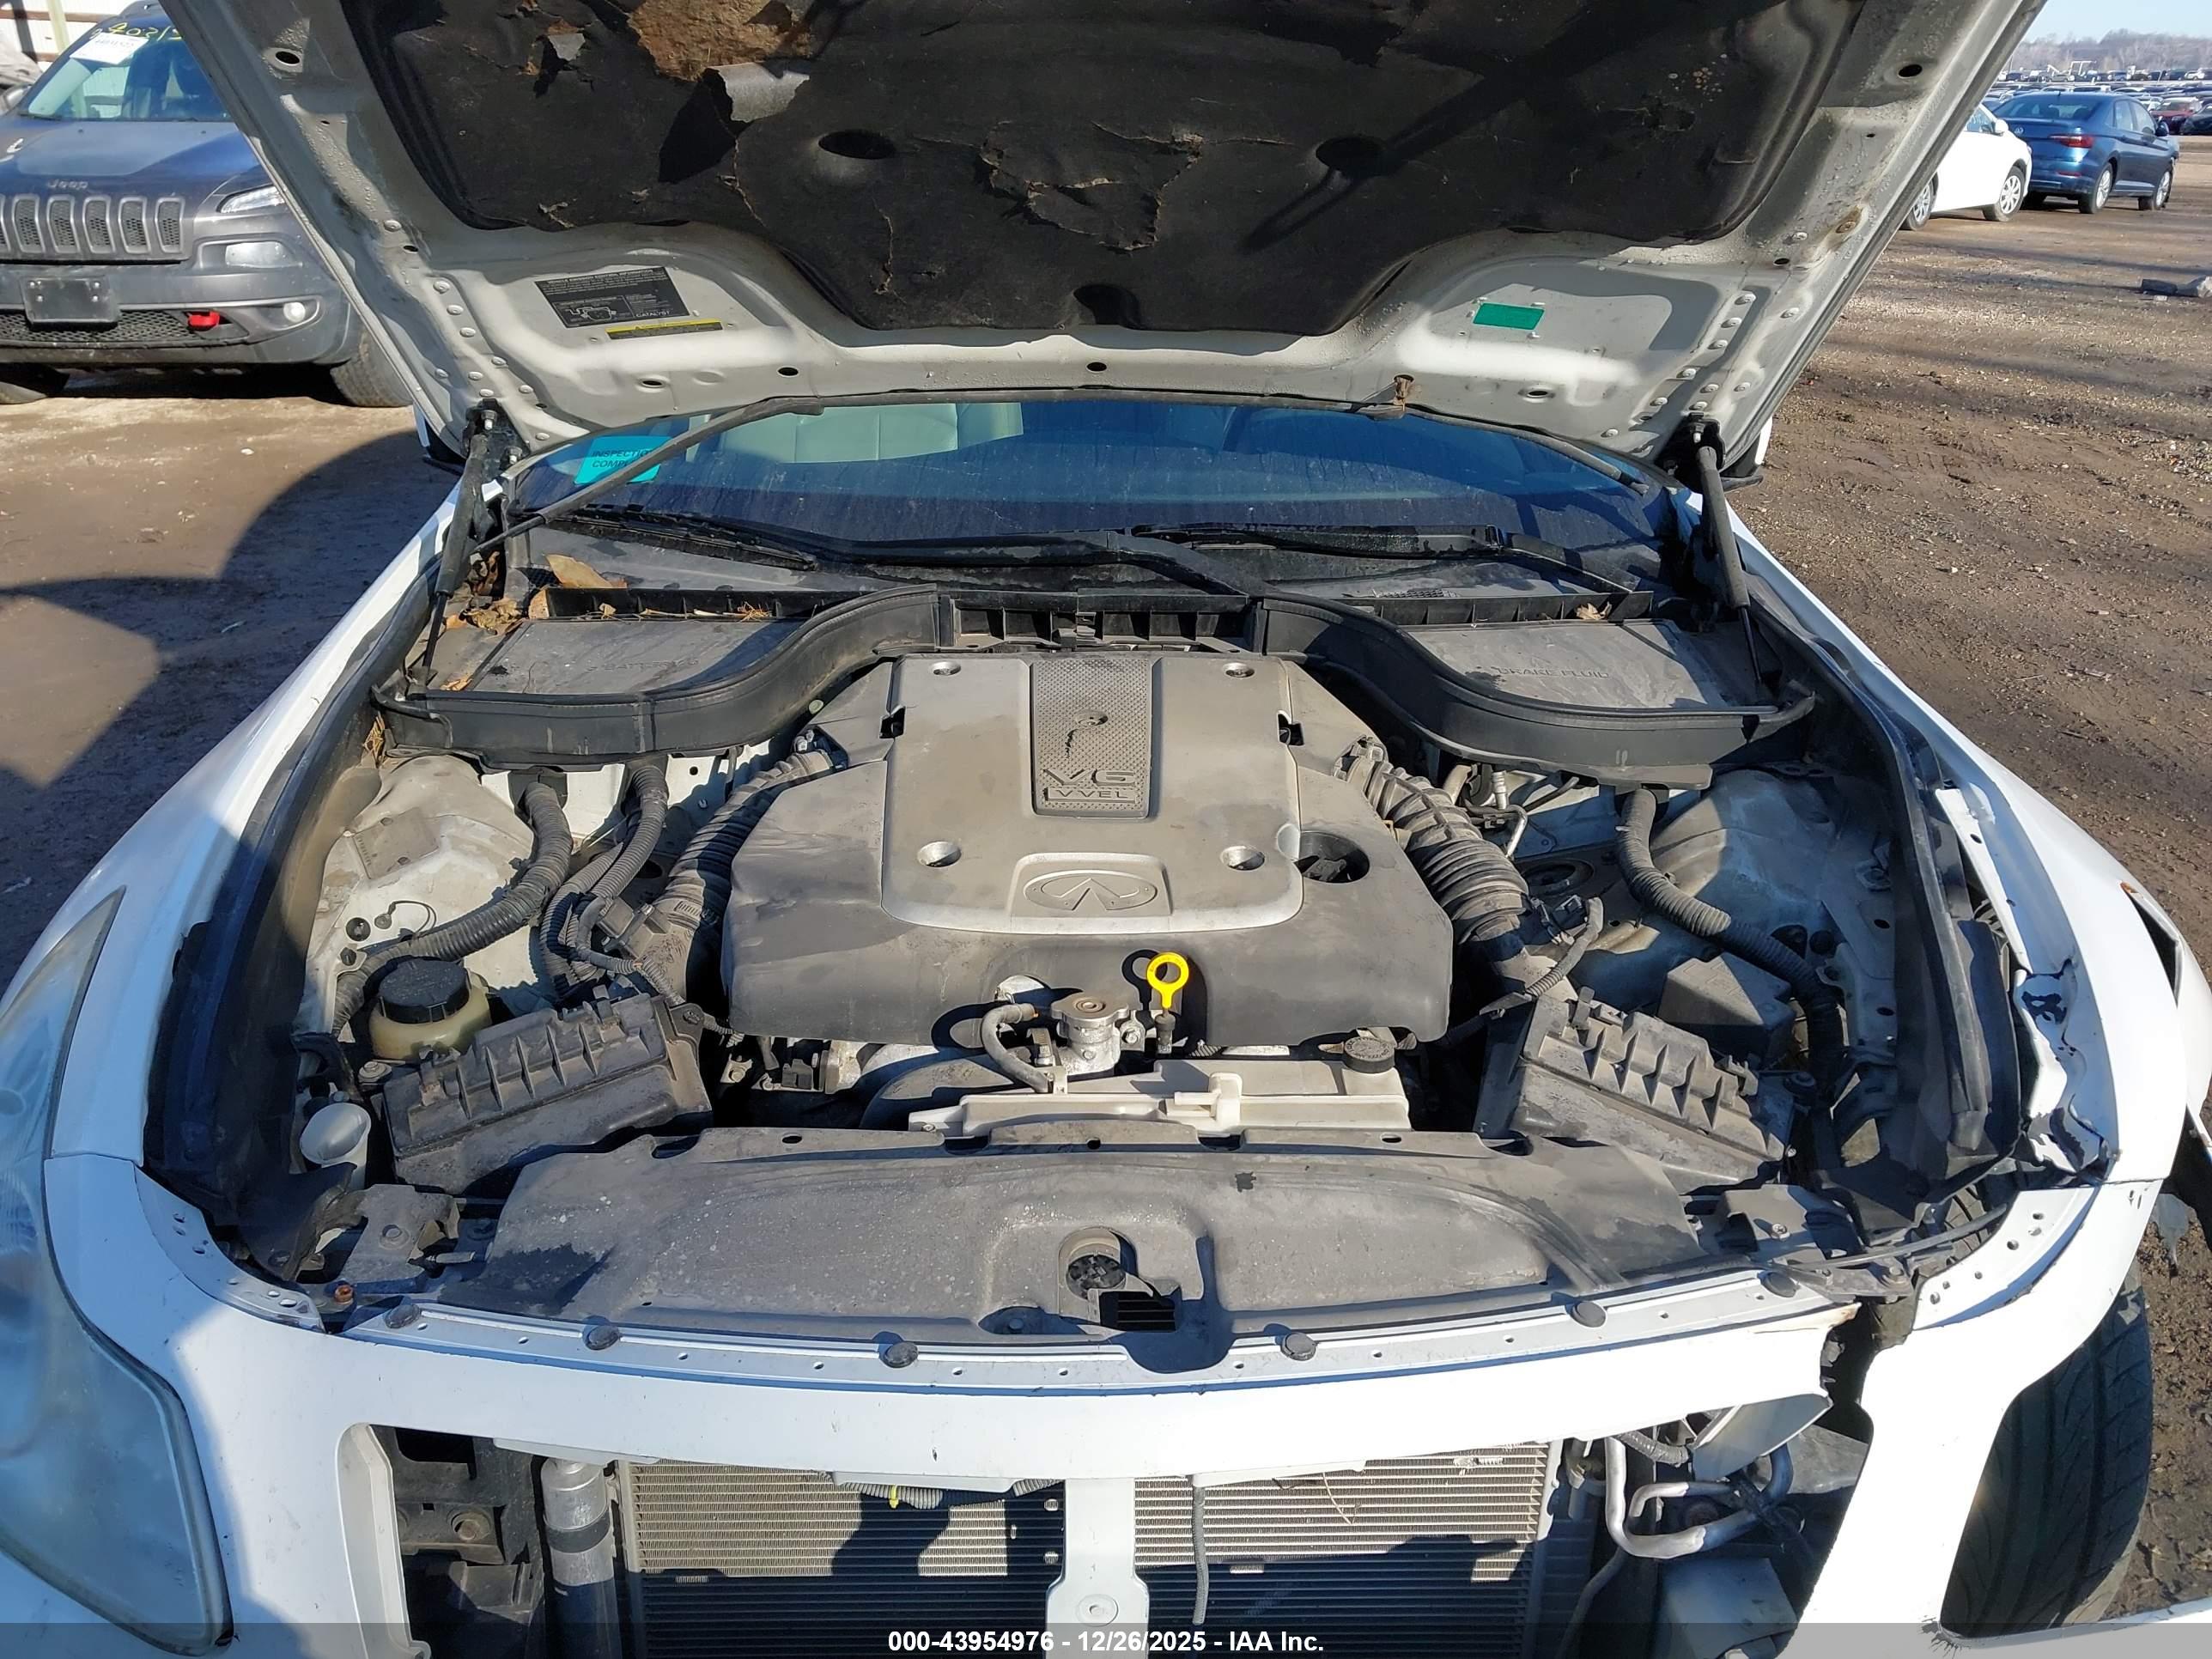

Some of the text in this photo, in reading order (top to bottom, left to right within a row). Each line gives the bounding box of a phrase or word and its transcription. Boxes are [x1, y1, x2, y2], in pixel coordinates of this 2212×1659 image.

[47, 179, 88, 190] Jeep
[592, 449, 652, 458] INSPECTIO
[1042, 769, 1135, 787] V6
[1055, 789, 1129, 799] VVEL
